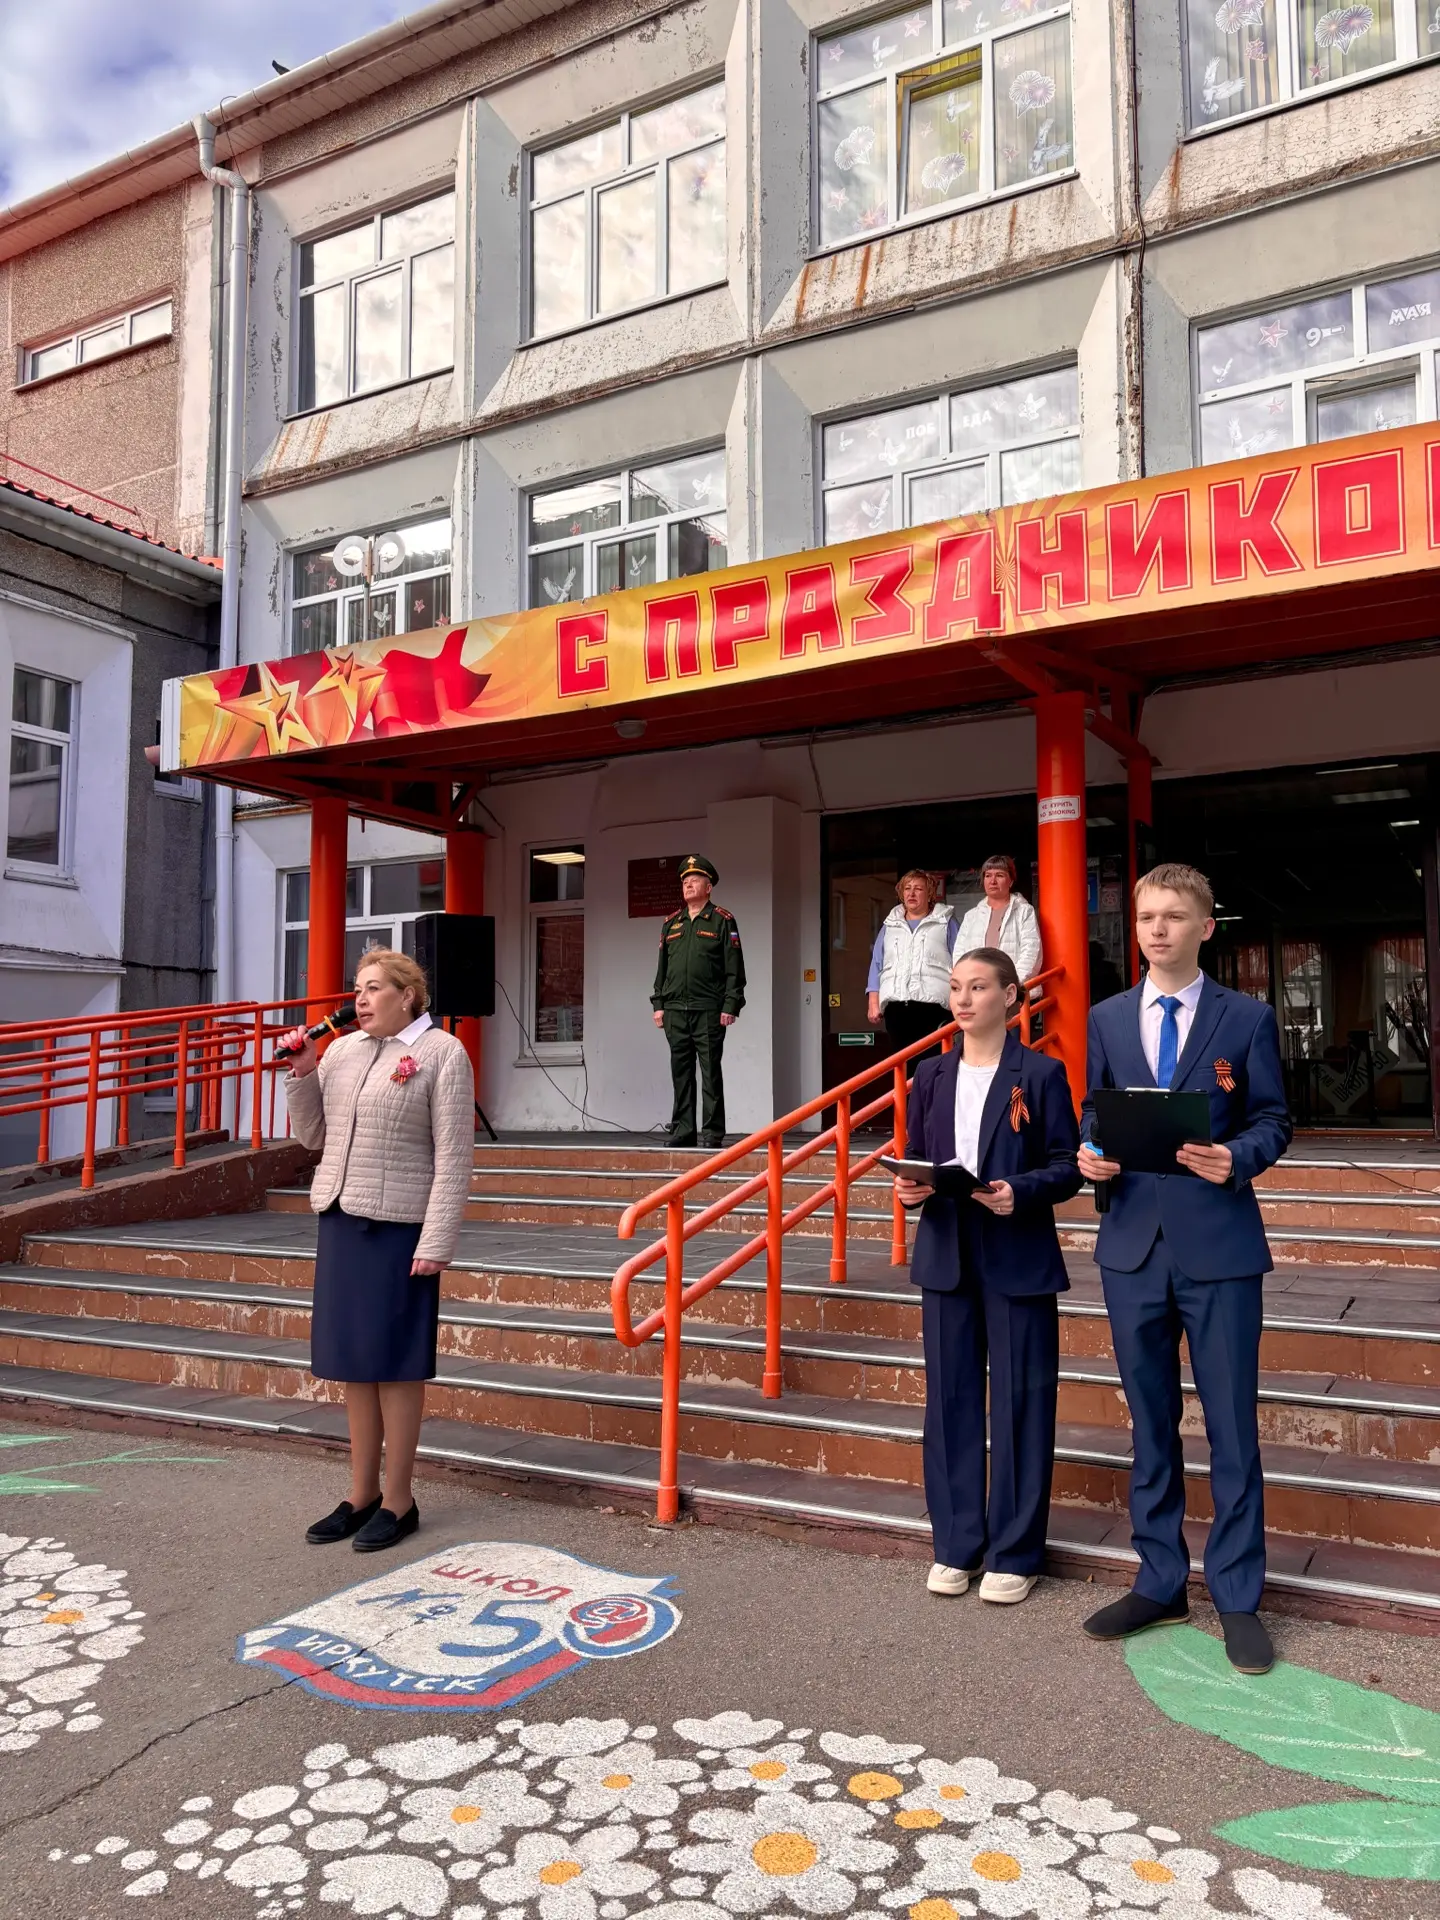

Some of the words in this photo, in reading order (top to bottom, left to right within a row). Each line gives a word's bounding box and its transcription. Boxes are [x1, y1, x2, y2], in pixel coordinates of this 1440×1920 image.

[1388, 302, 1432, 326] МАЯ
[556, 609, 610, 699] С
[644, 440, 1440, 684] ПРАЗДНИКО
[295, 1634, 486, 1691] ИРКУТСК
